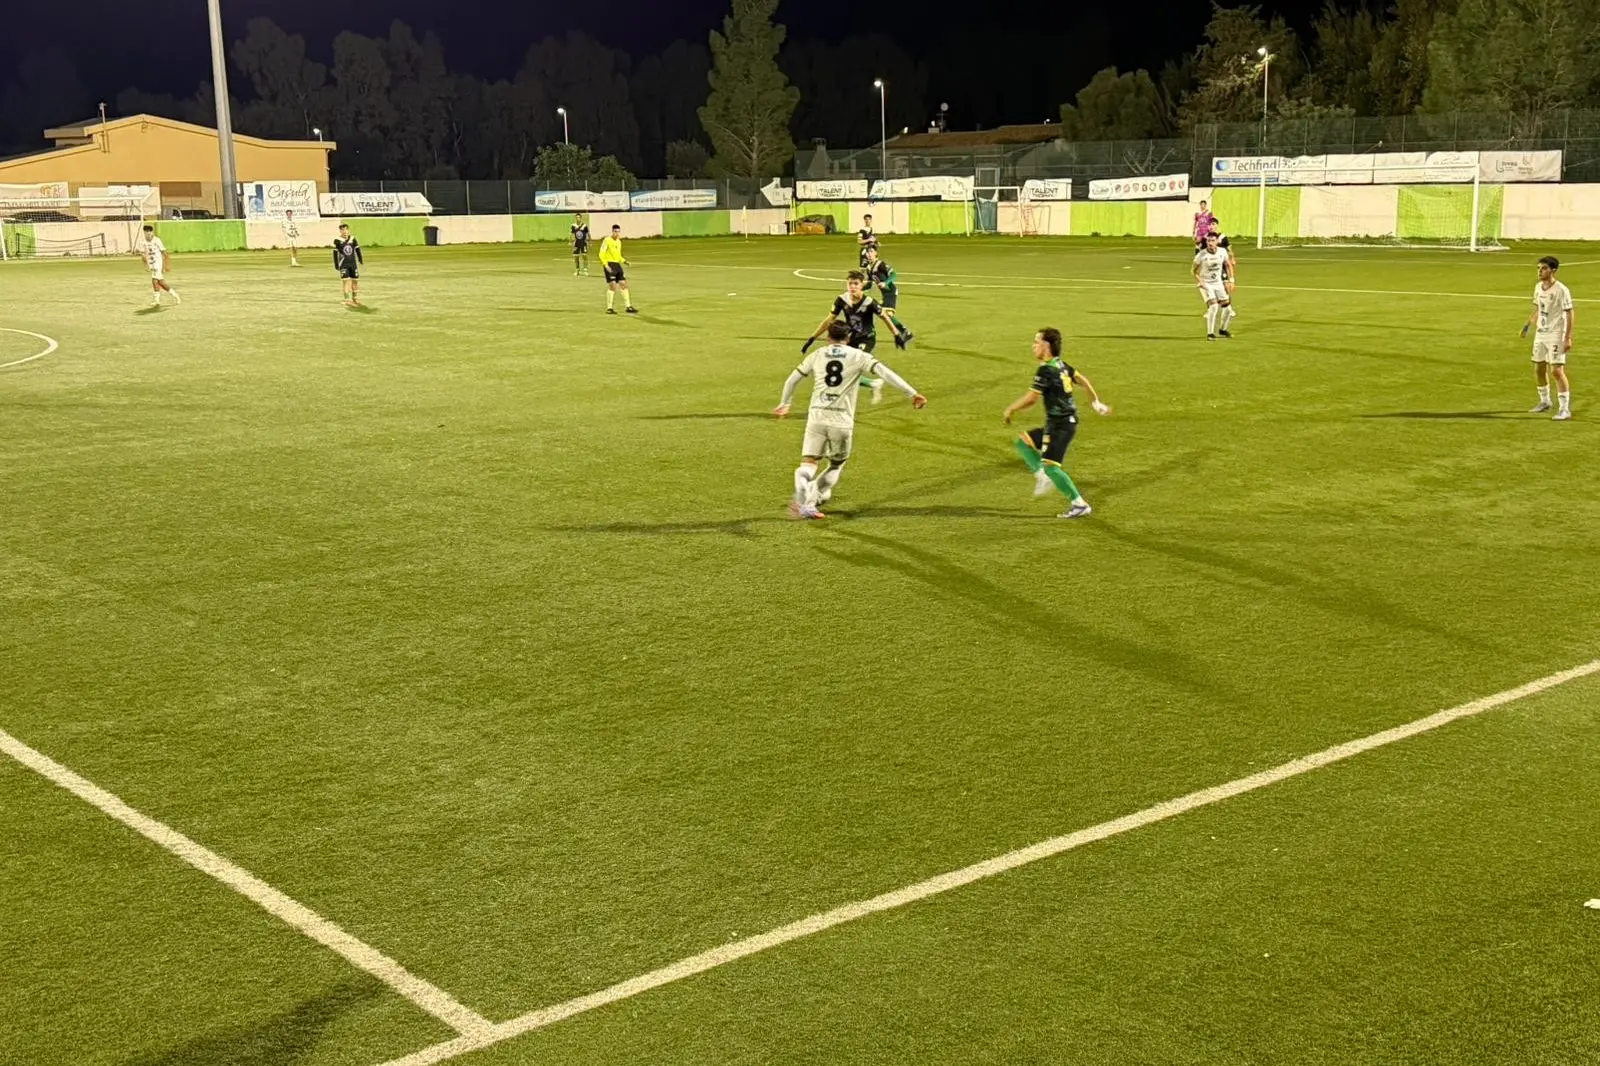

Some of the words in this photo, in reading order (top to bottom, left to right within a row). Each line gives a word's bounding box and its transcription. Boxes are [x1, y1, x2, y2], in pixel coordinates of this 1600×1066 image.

[1232, 159, 1277, 171] Techfind
[267, 182, 311, 200] Casula
[1552, 344, 1559, 353] 2
[824, 360, 844, 388] 8
